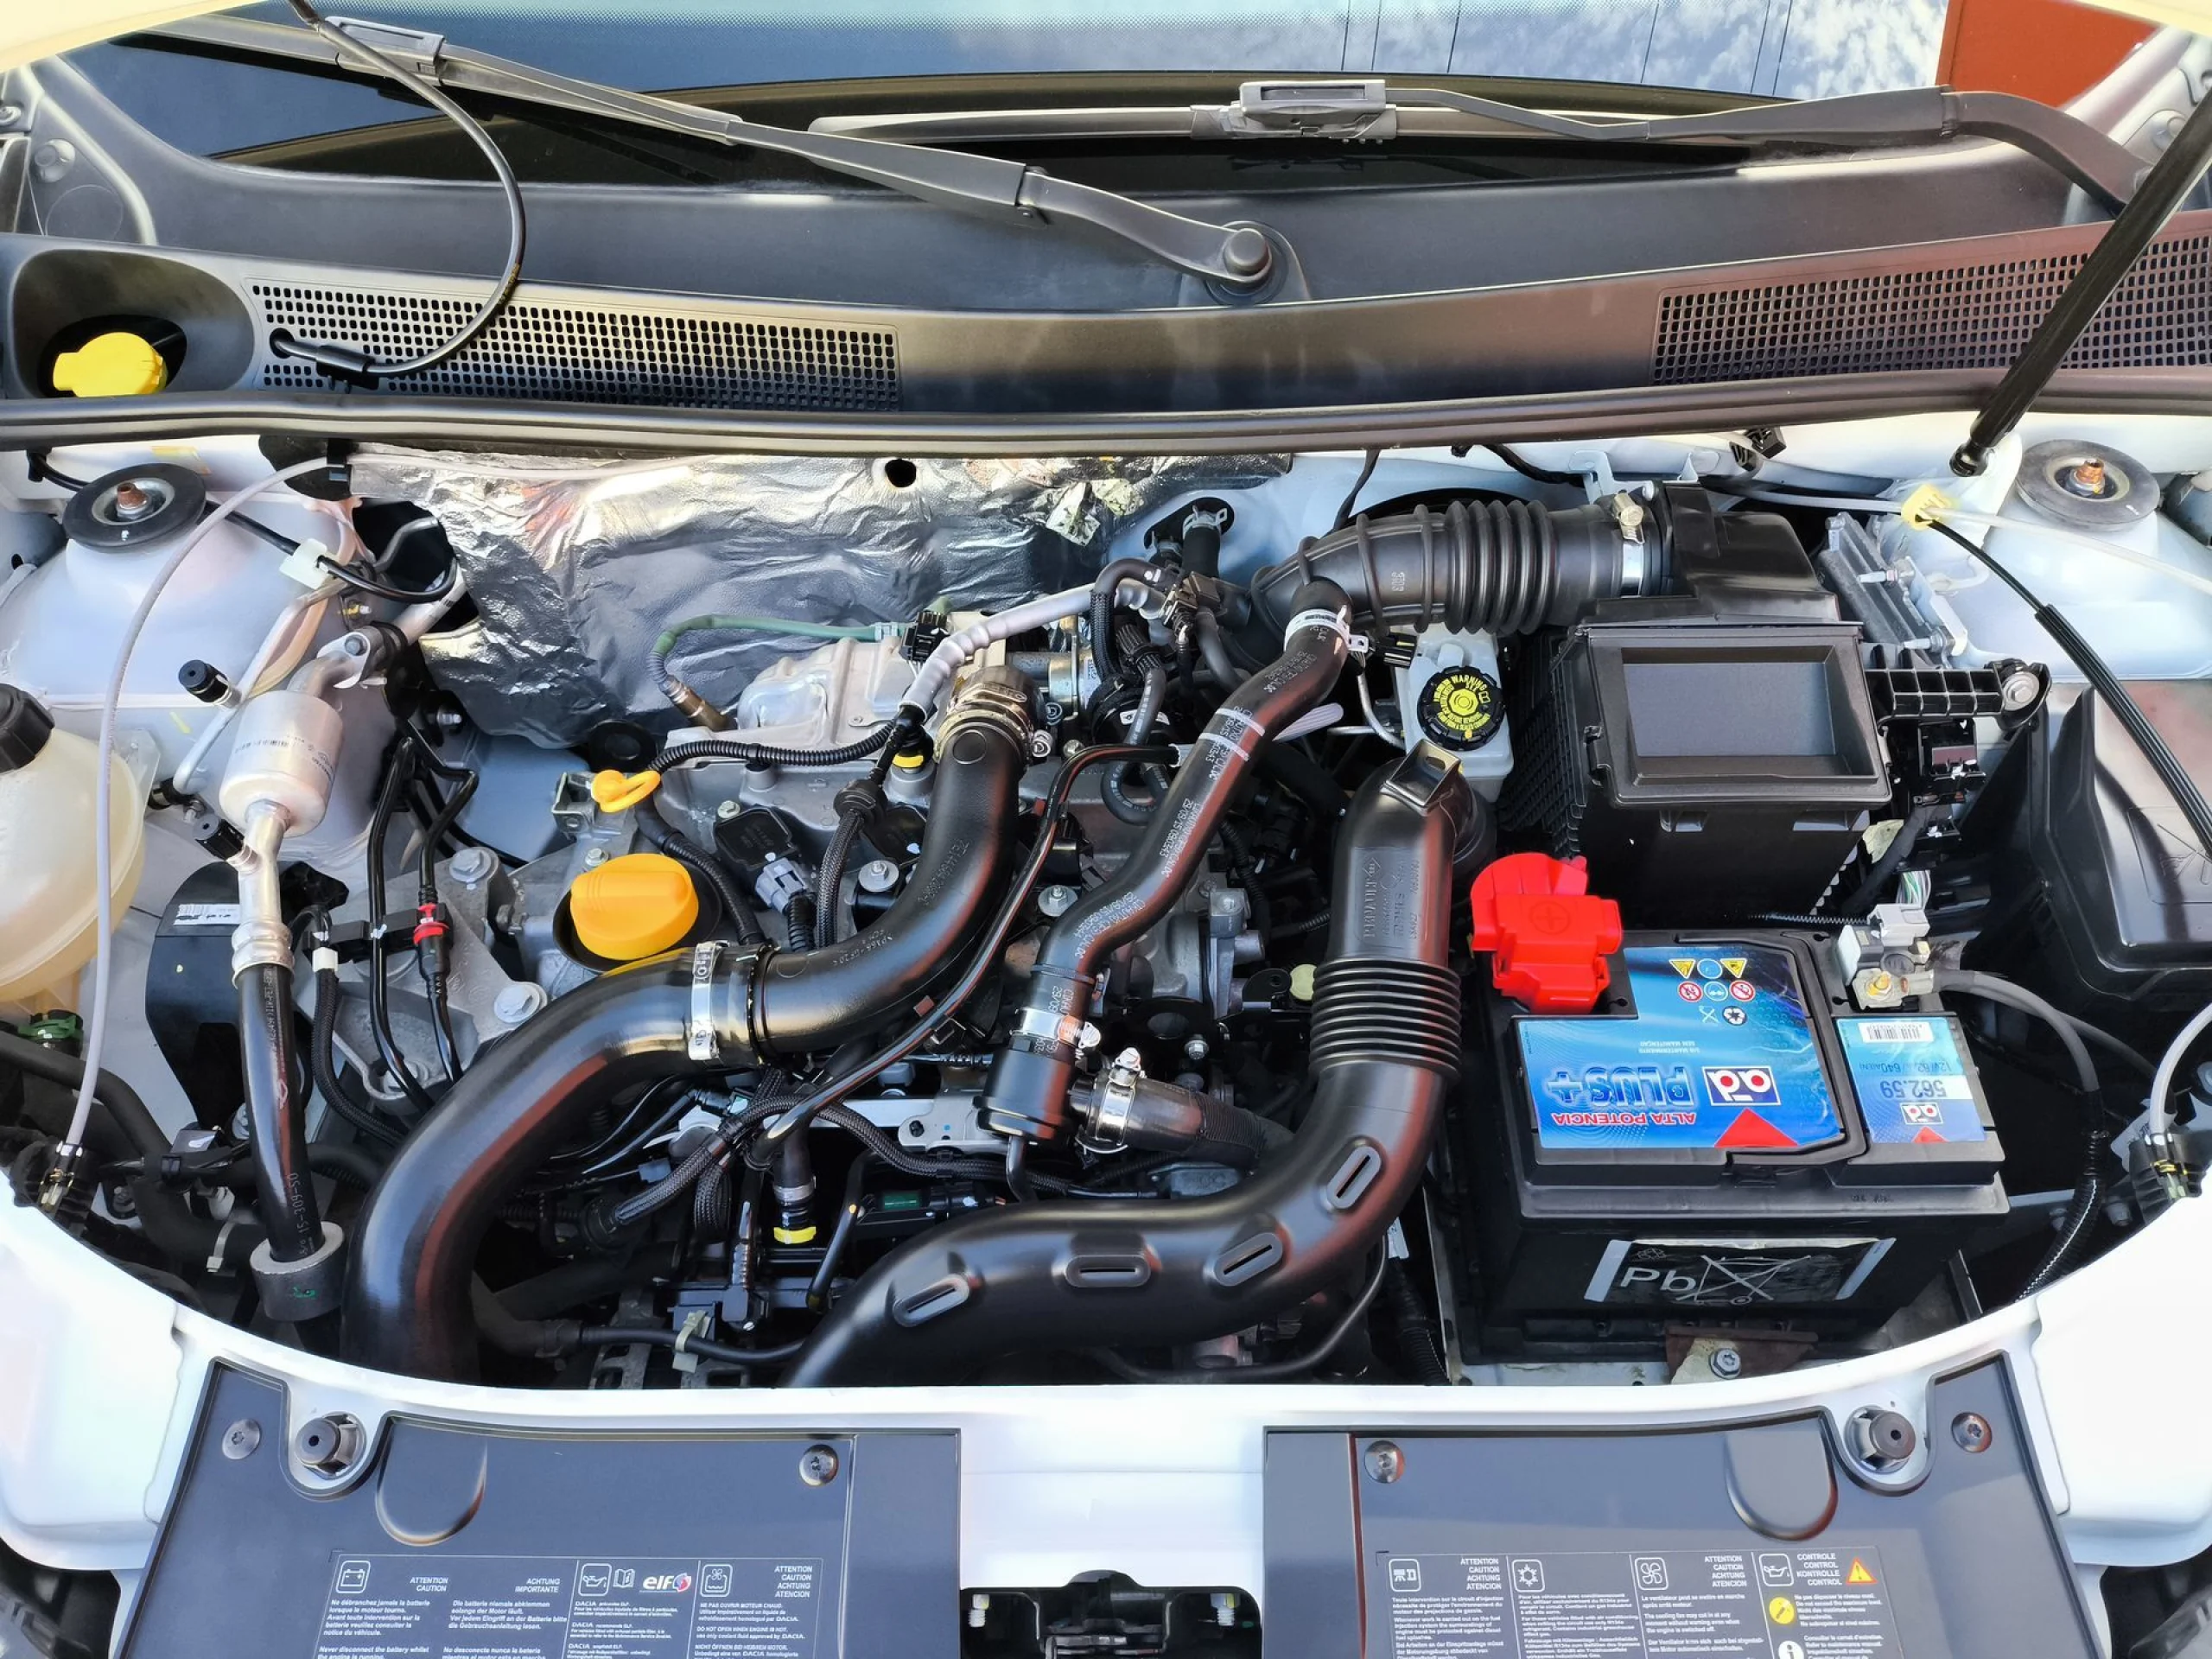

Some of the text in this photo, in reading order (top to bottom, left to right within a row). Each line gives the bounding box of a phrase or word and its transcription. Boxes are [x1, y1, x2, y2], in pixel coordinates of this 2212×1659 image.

[1548, 1065, 1694, 1107] PLUS+
[1706, 1069, 1772, 1103] ad
[1879, 1079, 1947, 1098] 562.59
[1551, 1112, 1697, 1125] ALTA POTENCIA
[1620, 1267, 1696, 1292] Pb
[643, 1576, 674, 1590] elf
